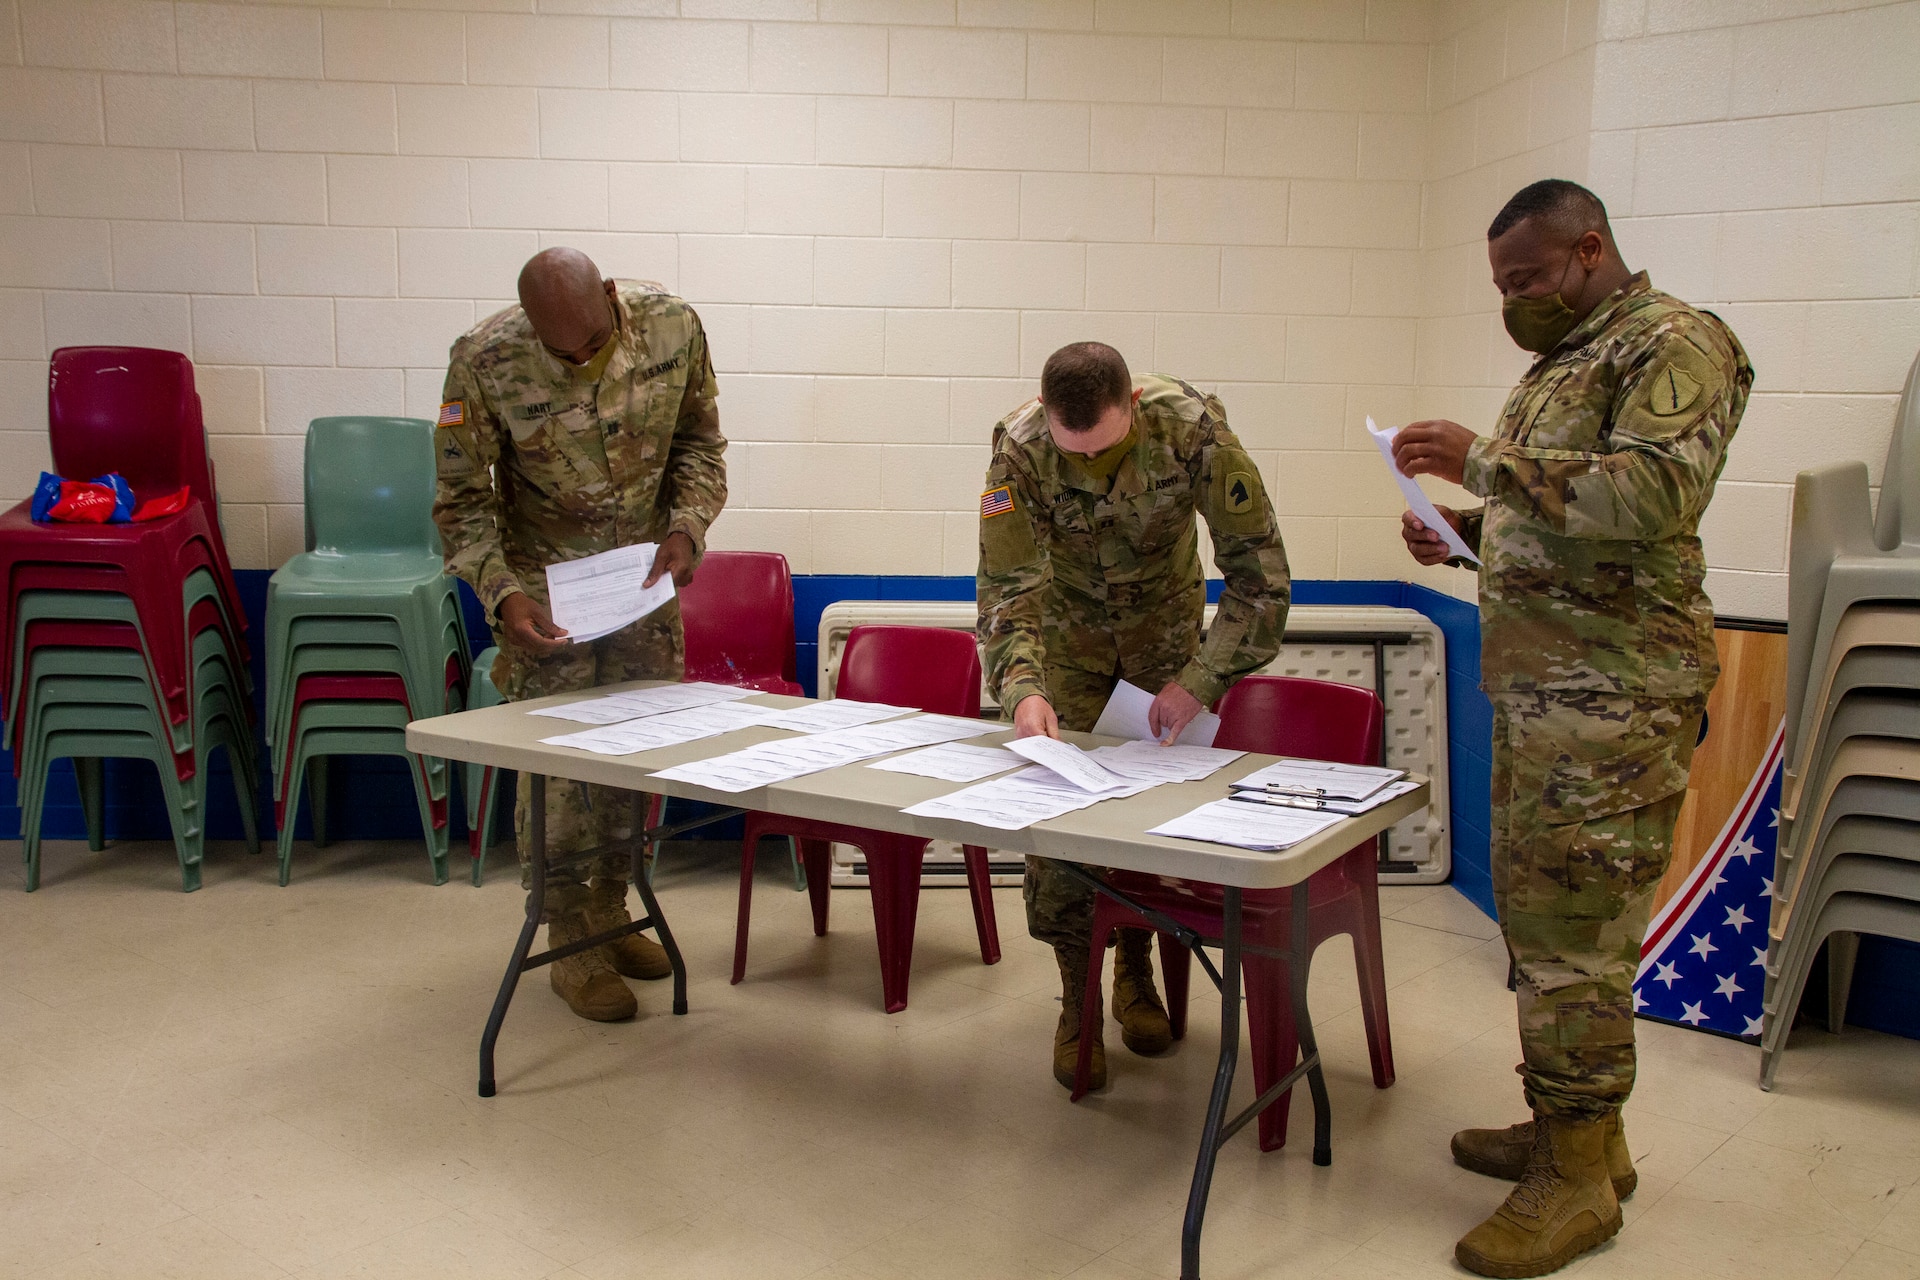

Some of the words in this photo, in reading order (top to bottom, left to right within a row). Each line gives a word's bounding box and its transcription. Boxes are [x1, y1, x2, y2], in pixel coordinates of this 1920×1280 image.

[655, 357, 679, 374] ARMY
[527, 402, 551, 416] HART
[1155, 474, 1179, 491] ARMY
